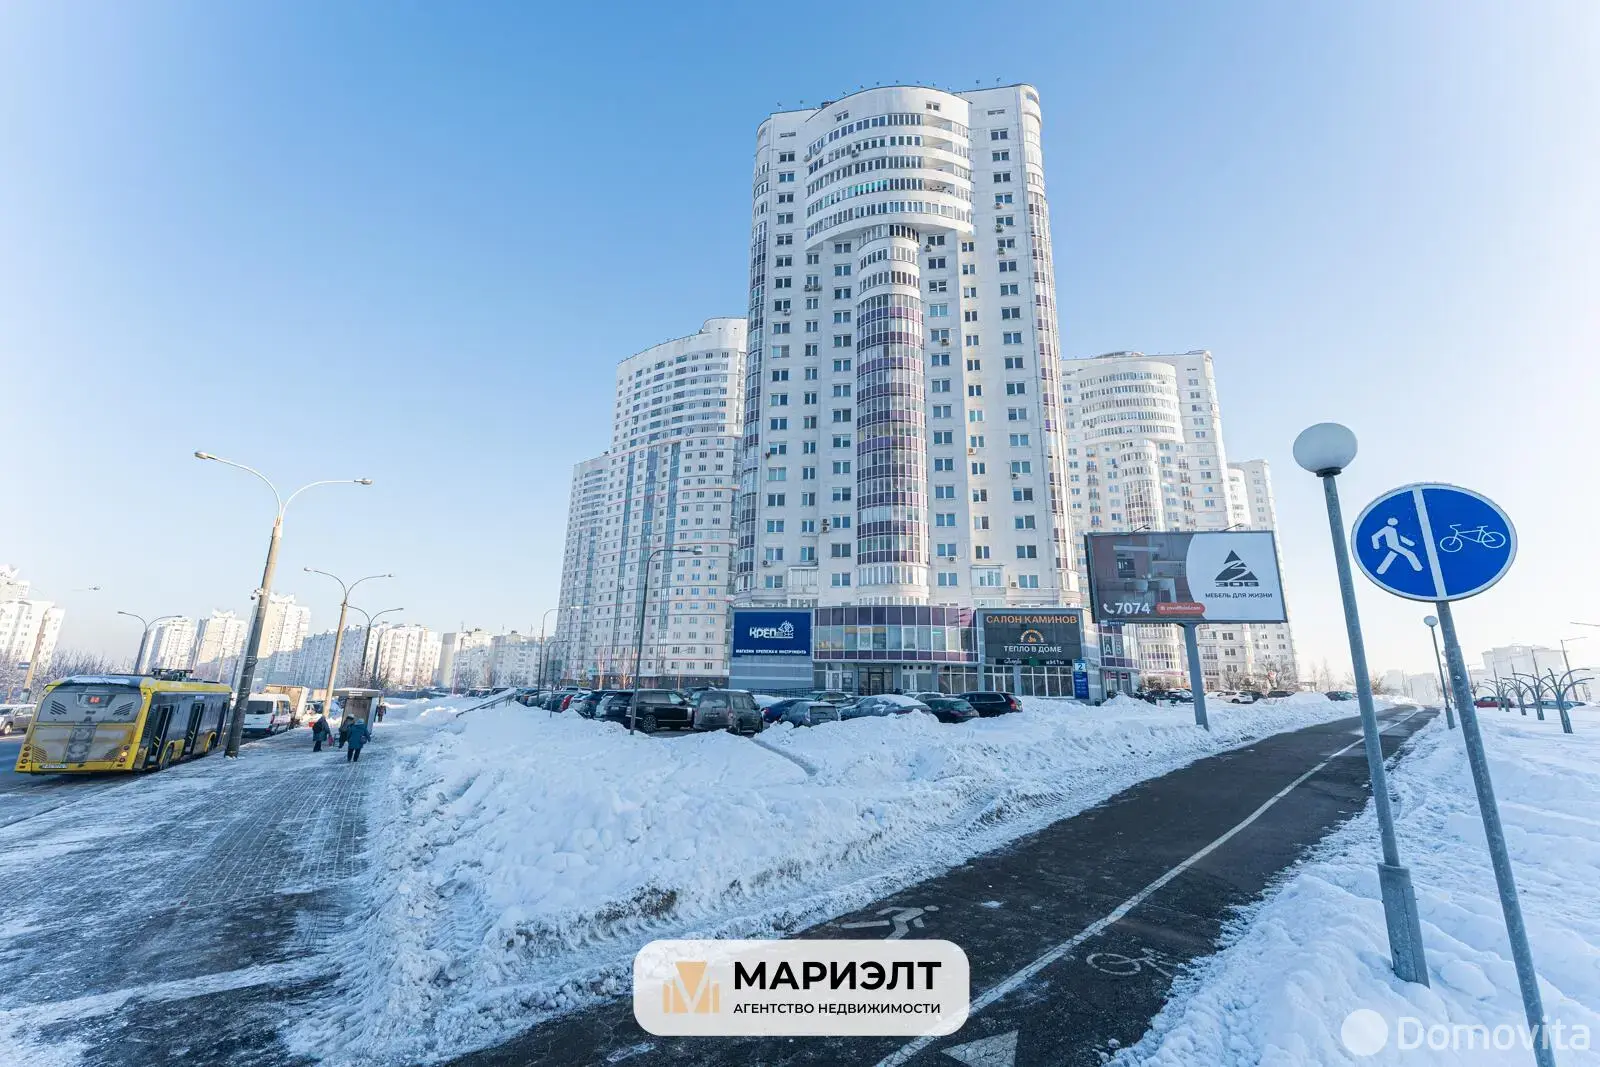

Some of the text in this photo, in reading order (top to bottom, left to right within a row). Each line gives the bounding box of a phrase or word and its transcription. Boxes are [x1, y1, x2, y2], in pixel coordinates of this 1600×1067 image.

[1115, 602, 1151, 614] 7074
[986, 615, 1078, 624] САЛОН КАМИНОВ
[1004, 645, 1030, 653] ТЕПЛО
[1038, 645, 1062, 653] ДОМЕ
